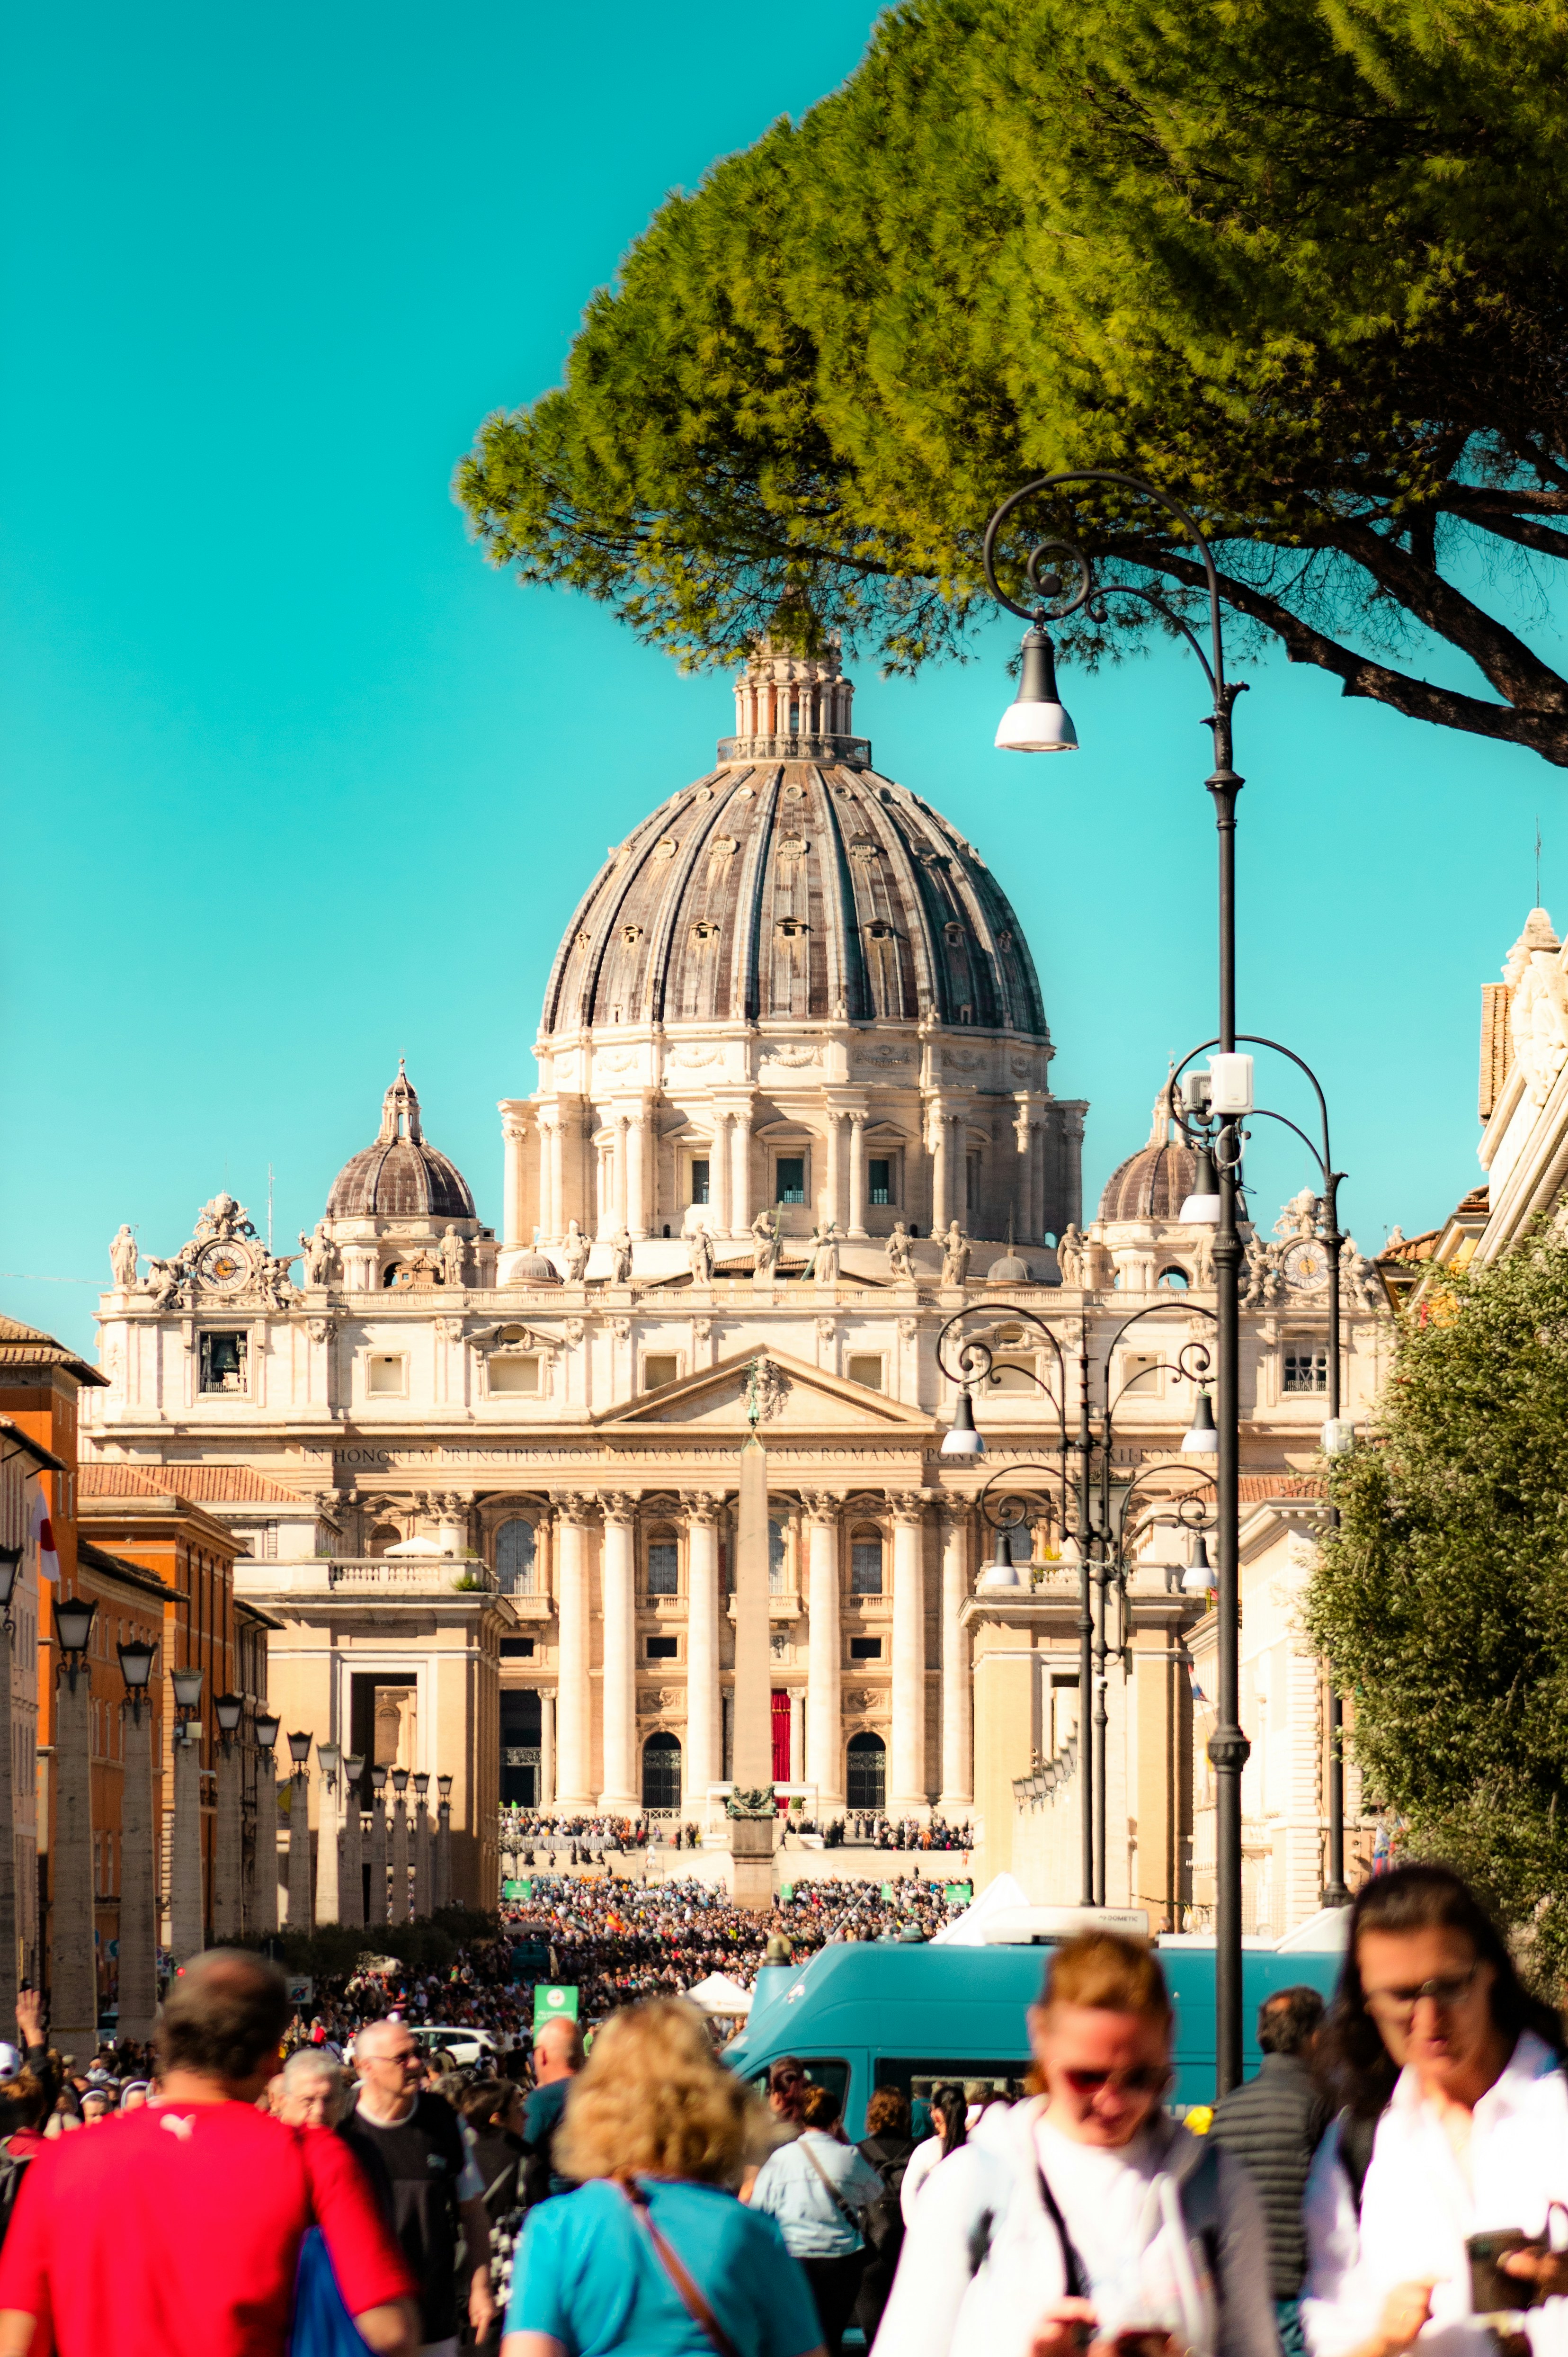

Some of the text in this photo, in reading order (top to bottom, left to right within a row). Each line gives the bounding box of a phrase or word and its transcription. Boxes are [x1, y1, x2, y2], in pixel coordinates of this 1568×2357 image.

[303, 1448, 324, 1462] IN
[333, 1448, 433, 1462] HONOREM
[440, 1448, 539, 1462] PRINCIPIS
[544, 1447, 604, 1462] APOST
[607, 1447, 672, 1462] PAVLVS
[820, 1446, 920, 1461] ROMANVS
